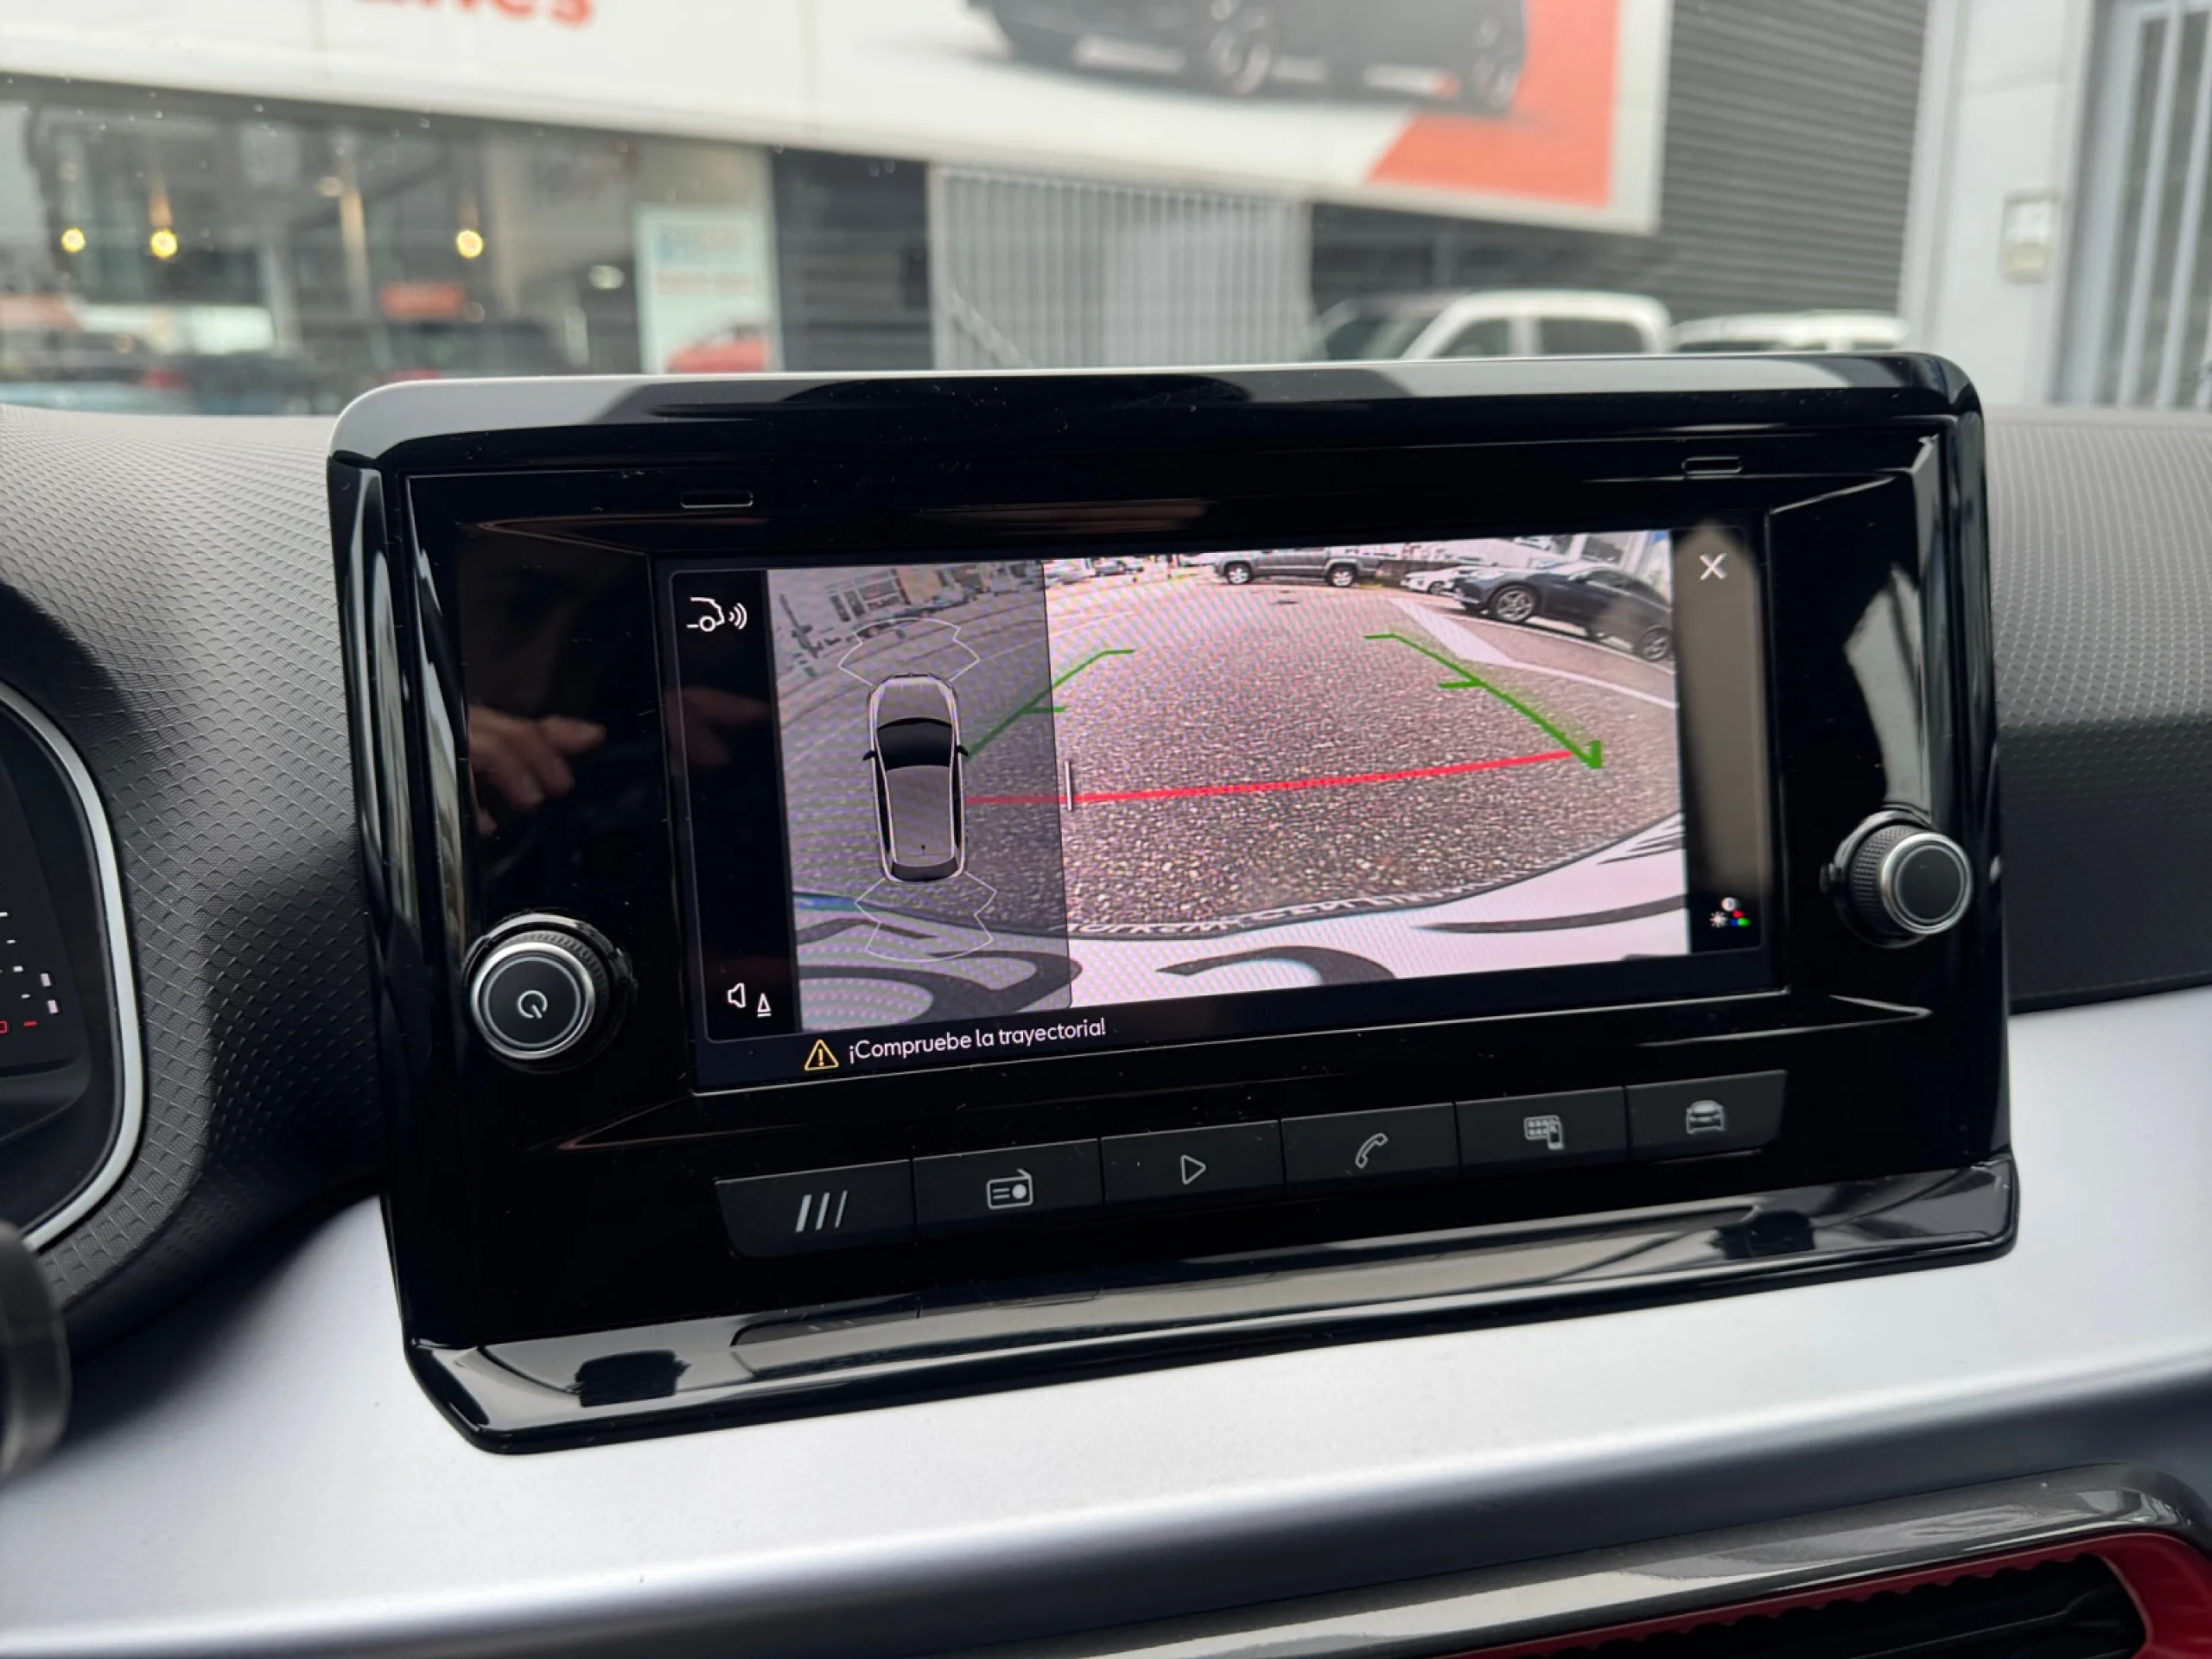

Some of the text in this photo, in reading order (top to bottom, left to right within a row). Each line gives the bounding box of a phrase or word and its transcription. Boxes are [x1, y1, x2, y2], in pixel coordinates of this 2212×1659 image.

[849, 1017, 1107, 1065] ¡Compruebe la trayectoria!
